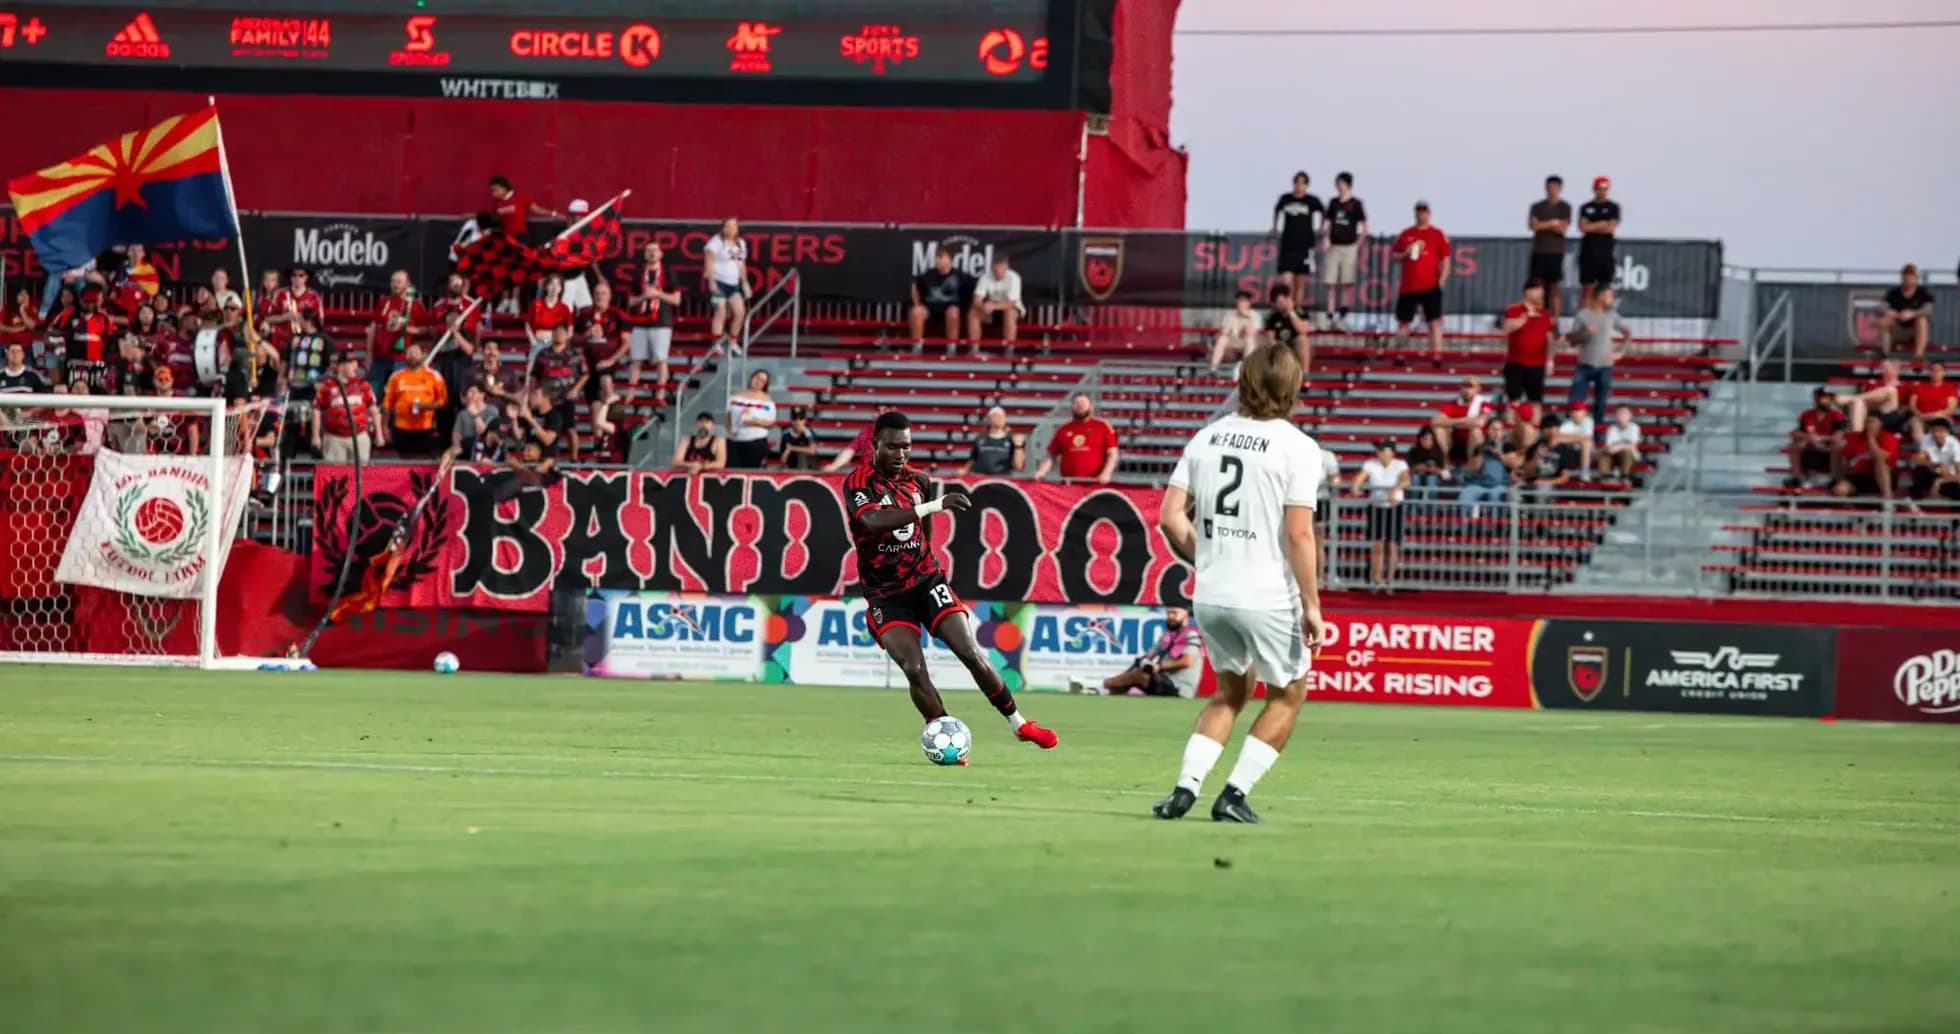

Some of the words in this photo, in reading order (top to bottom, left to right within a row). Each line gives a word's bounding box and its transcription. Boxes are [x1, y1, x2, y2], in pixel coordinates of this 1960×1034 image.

[510, 29, 614, 58] CIRCLE
[840, 35, 920, 59] SPORTS
[293, 228, 389, 267] Modelo
[912, 240, 995, 278] Mdel
[1208, 432, 1271, 454] McFADDEN
[1214, 454, 1245, 518] 2
[1216, 525, 1258, 541] TOYOTA
[929, 583, 954, 609] 13
[613, 602, 755, 643] ASMC
[1349, 622, 1496, 652] PARTNER
[1345, 650, 1377, 668] OF
[1304, 669, 1376, 692] ENIX
[1383, 672, 1494, 698] RISING
[1645, 669, 1740, 690] AMERICA
[1741, 672, 1805, 691] FIRST
